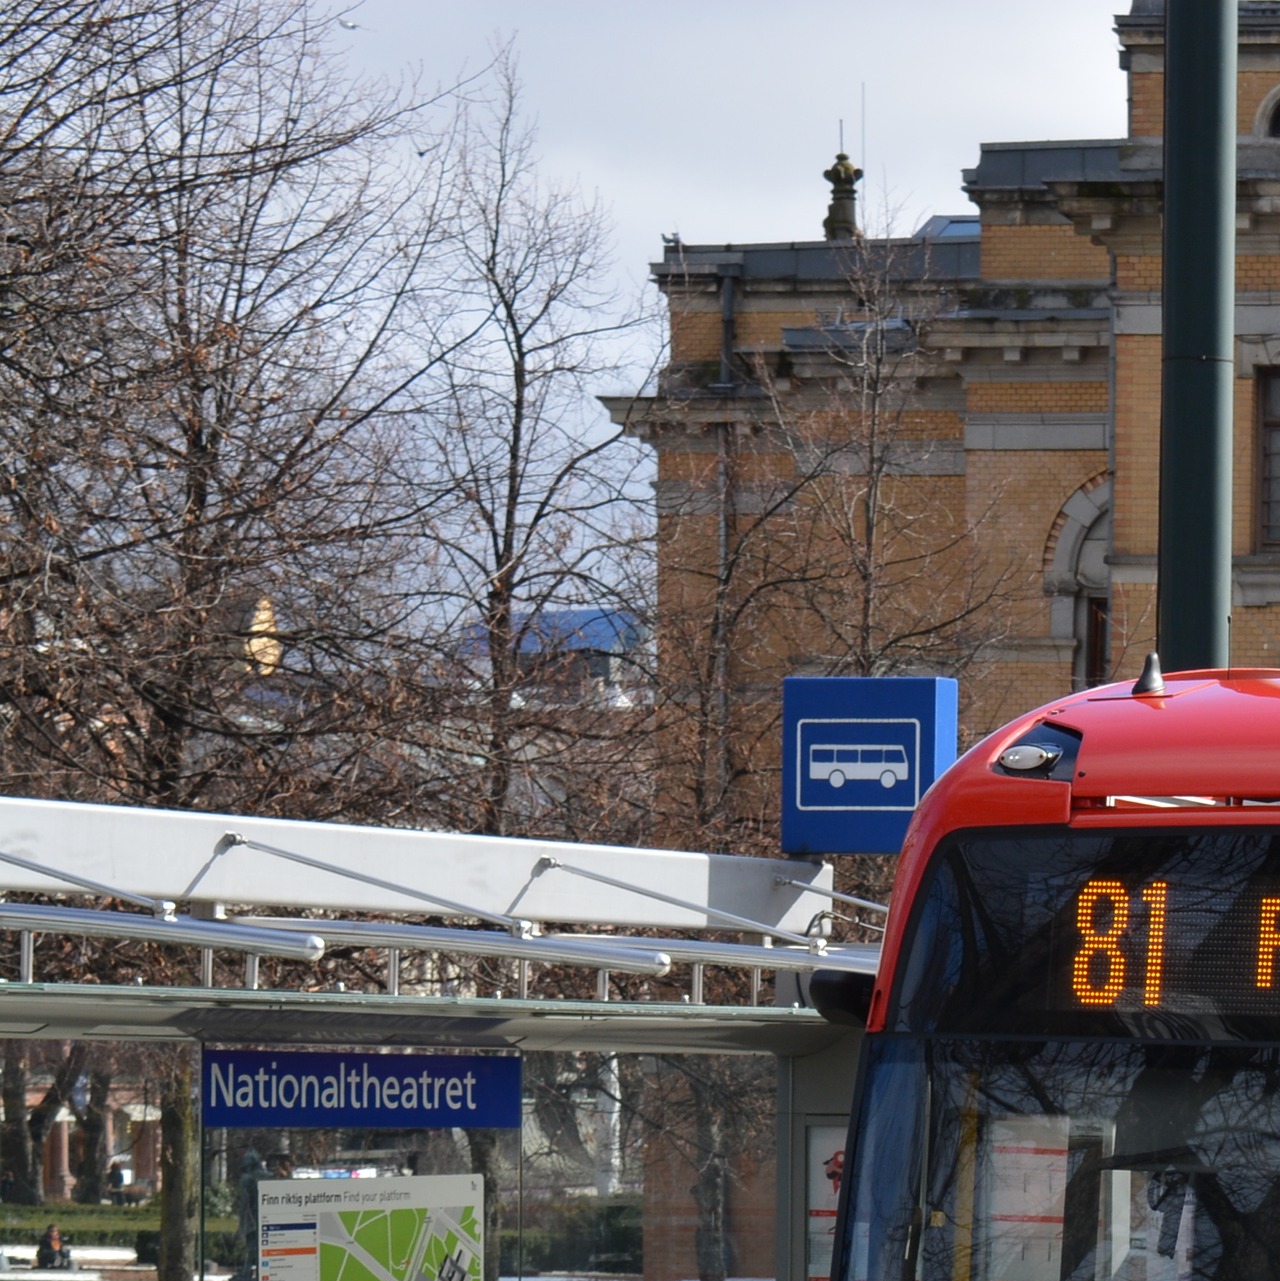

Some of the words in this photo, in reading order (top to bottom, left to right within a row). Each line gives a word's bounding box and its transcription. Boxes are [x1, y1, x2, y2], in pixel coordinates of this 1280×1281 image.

[1071, 880, 1168, 1006] 81
[210, 1061, 477, 1110] Nationaltheatret
[261, 1193, 279, 1206] Finn
[281, 1192, 302, 1207] riktig
[304, 1192, 342, 1207] plattform
[343, 1190, 360, 1202] Find
[360, 1193, 378, 1204] your
[379, 1190, 411, 1203] platform
